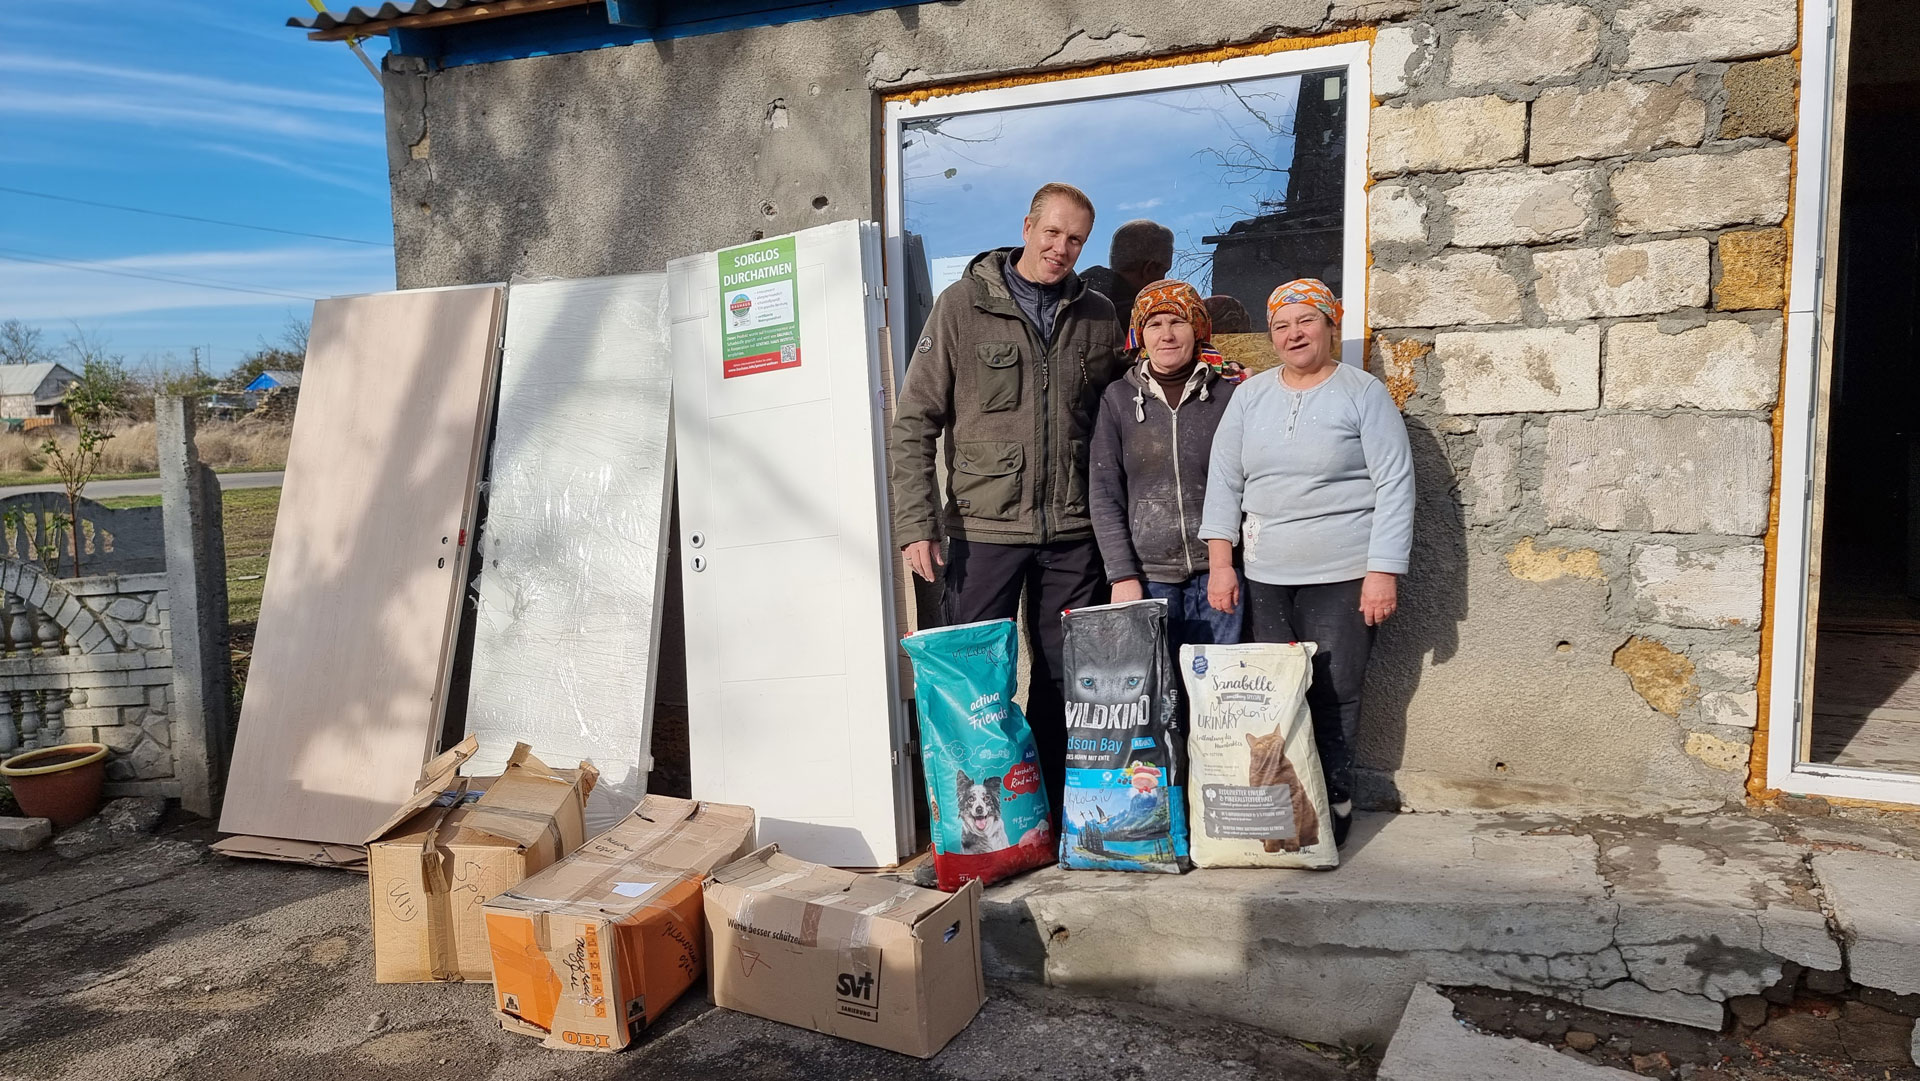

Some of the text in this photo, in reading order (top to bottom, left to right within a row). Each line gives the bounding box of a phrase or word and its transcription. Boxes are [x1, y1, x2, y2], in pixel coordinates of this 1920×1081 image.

[734, 248, 780, 268] SORGLOS
[723, 262, 792, 286] DURCHATMEN
[1212, 674, 1275, 692] Sanabelle
[970, 692, 1000, 711] activa
[968, 707, 1008, 731] Friends
[1197, 714, 1239, 730] URINARY
[1067, 736, 1123, 755] dson Bay
[1010, 776, 1025, 789] Rind
[727, 917, 747, 932] Werte
[748, 922, 771, 938] besser
[836, 971, 874, 1000] svt
[841, 1005, 871, 1017] SANIERUNG
[562, 1030, 610, 1048] OBI
